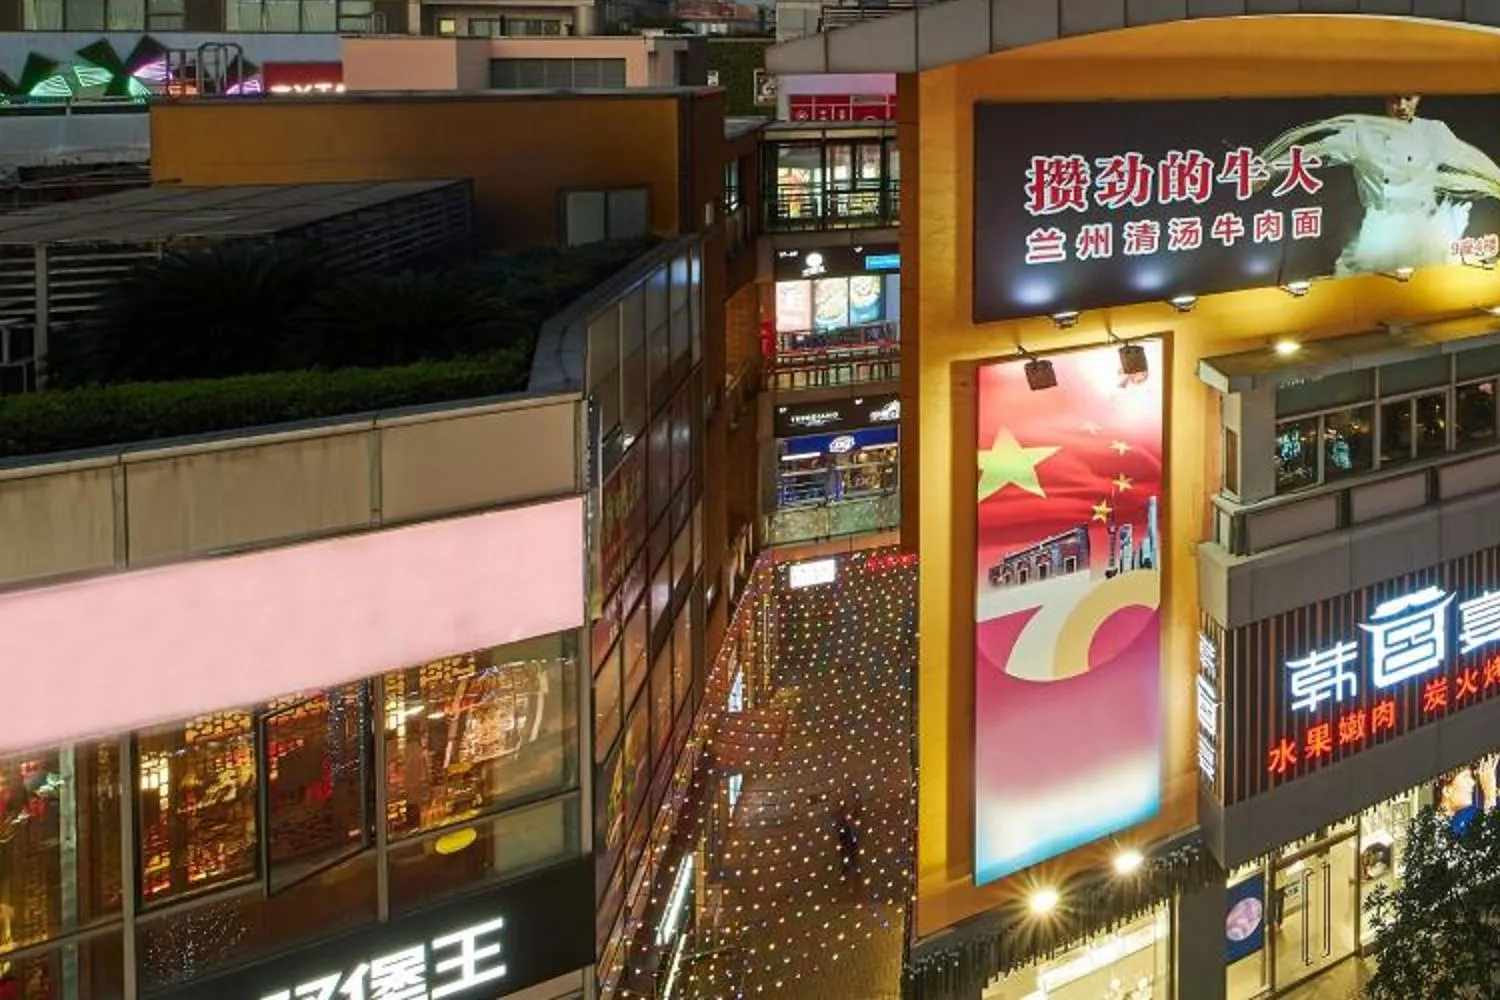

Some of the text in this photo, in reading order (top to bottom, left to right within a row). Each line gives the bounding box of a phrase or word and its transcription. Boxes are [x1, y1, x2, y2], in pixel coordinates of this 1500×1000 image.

[1025, 146, 1324, 216] 攒劲的牛大
[1025, 207, 1323, 264] 兰州清汤牛肉面
[1267, 699, 1397, 774] 水果嫩肉
